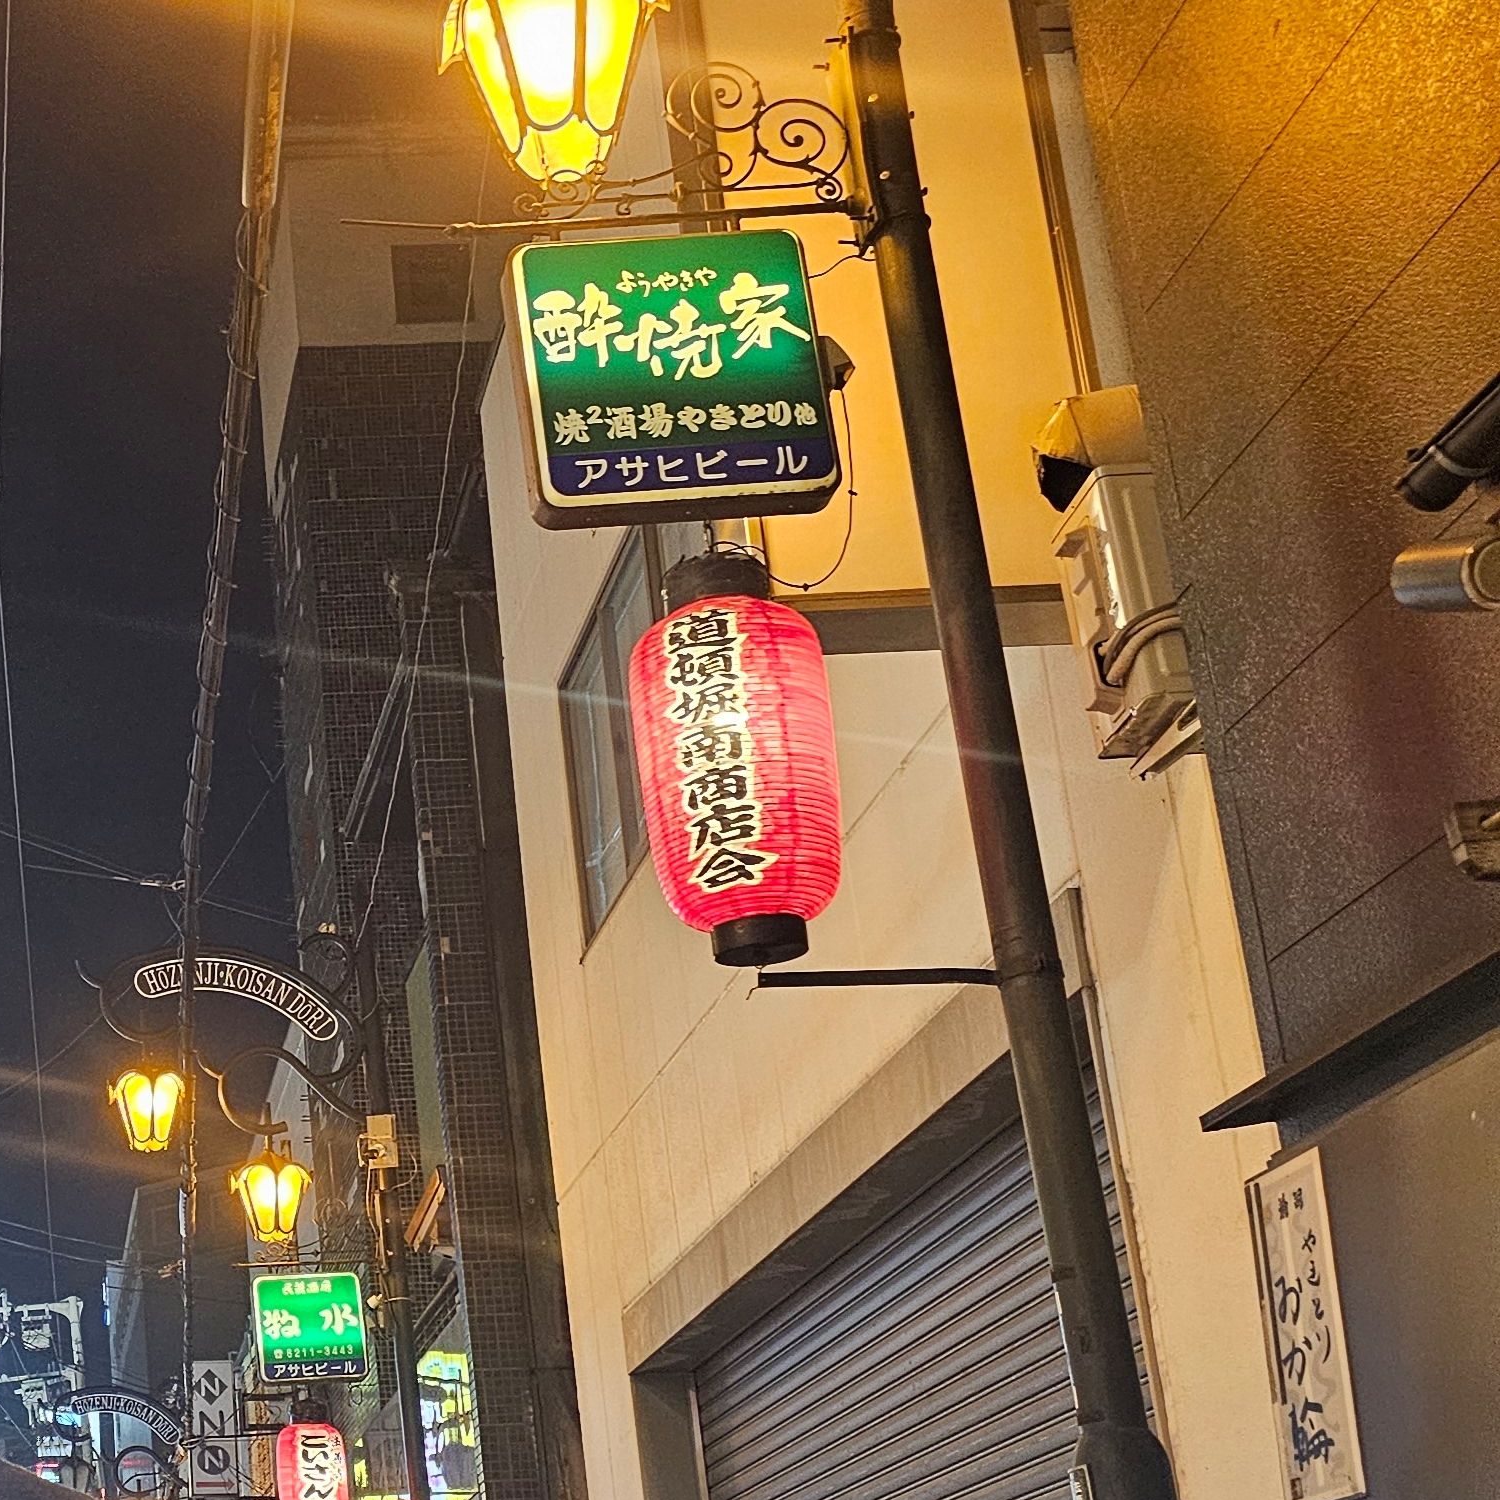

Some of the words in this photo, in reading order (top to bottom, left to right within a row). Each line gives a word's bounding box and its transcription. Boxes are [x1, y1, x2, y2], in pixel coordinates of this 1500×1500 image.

[616, 267, 717, 297] ようやきや
[575, 445, 808, 489] アサヒビール
[668, 611, 768, 889] 道頓堀南商店会
[273, 1360, 357, 1378] アサヒビール
